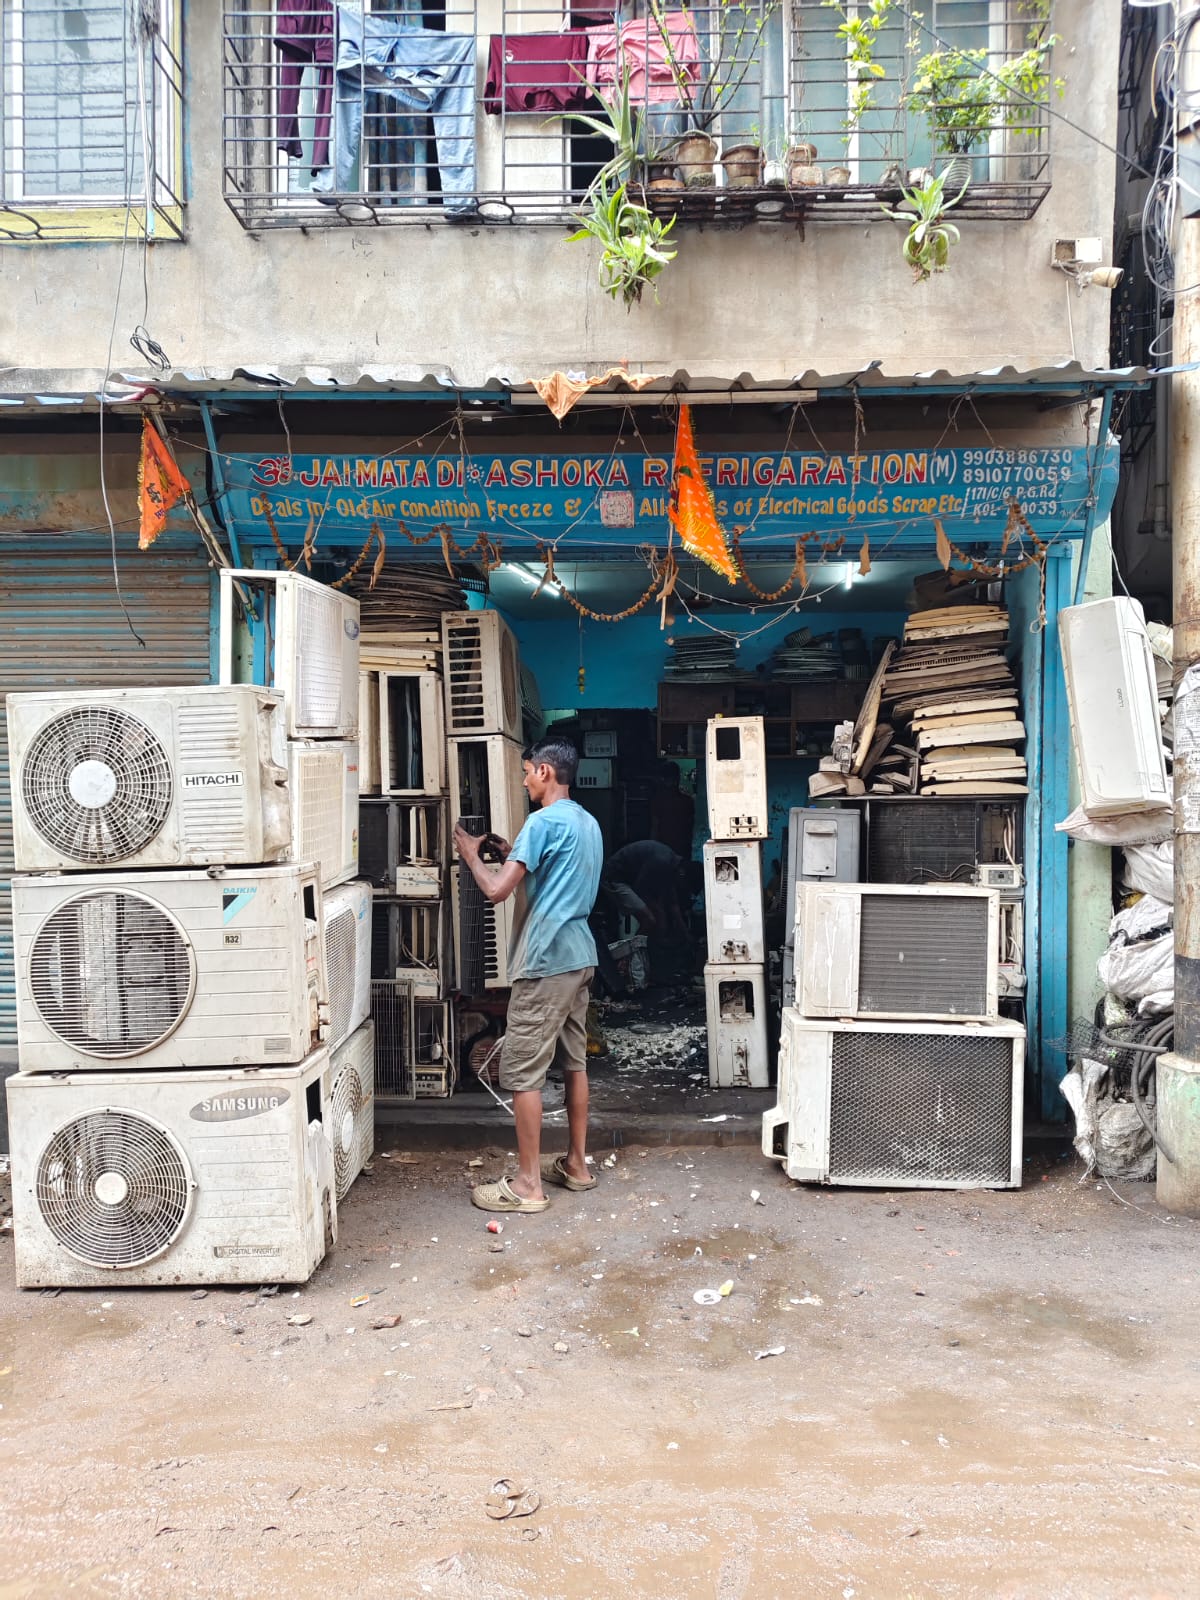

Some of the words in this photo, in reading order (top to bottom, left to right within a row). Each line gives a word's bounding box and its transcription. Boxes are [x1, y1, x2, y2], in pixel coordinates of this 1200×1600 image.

[963, 449, 1072, 465] 9903886730
[301, 458, 350, 487] JAI
[356, 459, 430, 487] MATA
[437, 459, 463, 487] DI
[484, 459, 629, 487] ASHOKA
[643, 453, 928, 486] RFRIGARATION
[930, 450, 957, 485] (M)
[963, 466, 1071, 483] 8910770059
[336, 498, 368, 517] Old
[372, 498, 396, 517] Air
[401, 500, 480, 518] Condition
[639, 497, 665, 517] All
[733, 497, 752, 516] of
[759, 496, 834, 515] Electrical
[837, 496, 888, 515] Goods
[892, 495, 937, 515] Scrap
[185, 774, 239, 786] HITACHI
[225, 935, 239, 944] R32
[201, 1096, 279, 1112] SAMSUNG
